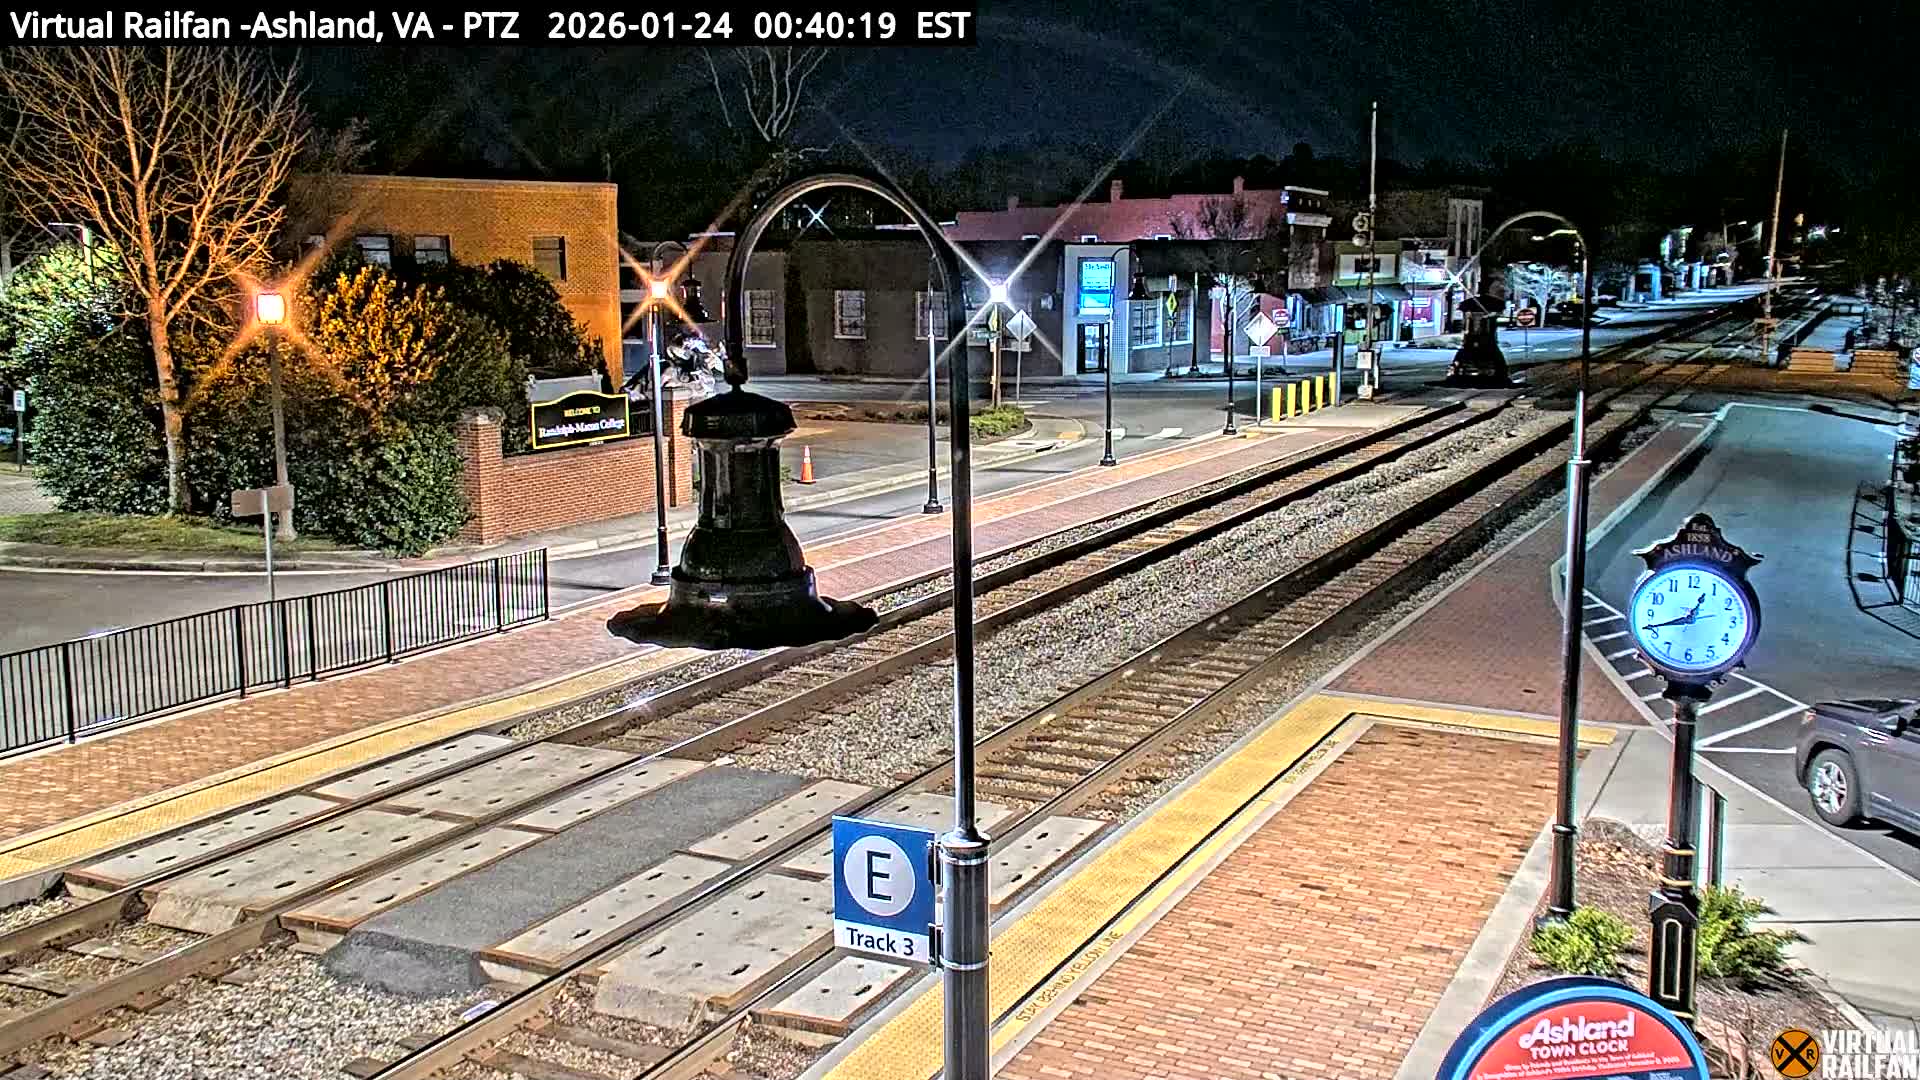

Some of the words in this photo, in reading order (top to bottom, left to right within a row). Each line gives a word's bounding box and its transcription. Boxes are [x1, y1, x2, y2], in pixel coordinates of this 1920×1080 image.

[1663, 543, 1733, 563] ASHLAND
[1669, 579, 1678, 592] 11
[1688, 575, 1701, 589] 12
[1711, 583, 1717, 596] 1
[1651, 592, 1665, 606] 10
[1724, 597, 1733, 611] 2
[1647, 608, 1654, 618] 9
[1728, 616, 1737, 629] 3
[1721, 633, 1729, 646] 4
[1663, 641, 1673, 658] 7
[1684, 647, 1693, 662] 6
[1706, 645, 1716, 659] 5
[866, 850, 893, 902] E
[846, 926, 898, 954] Track
[903, 937, 914, 956] 3
[1519, 1011, 1635, 1049] Ashland
[1530, 1043, 1576, 1060] TOWN
[1579, 1039, 1629, 1055] CLOCK
